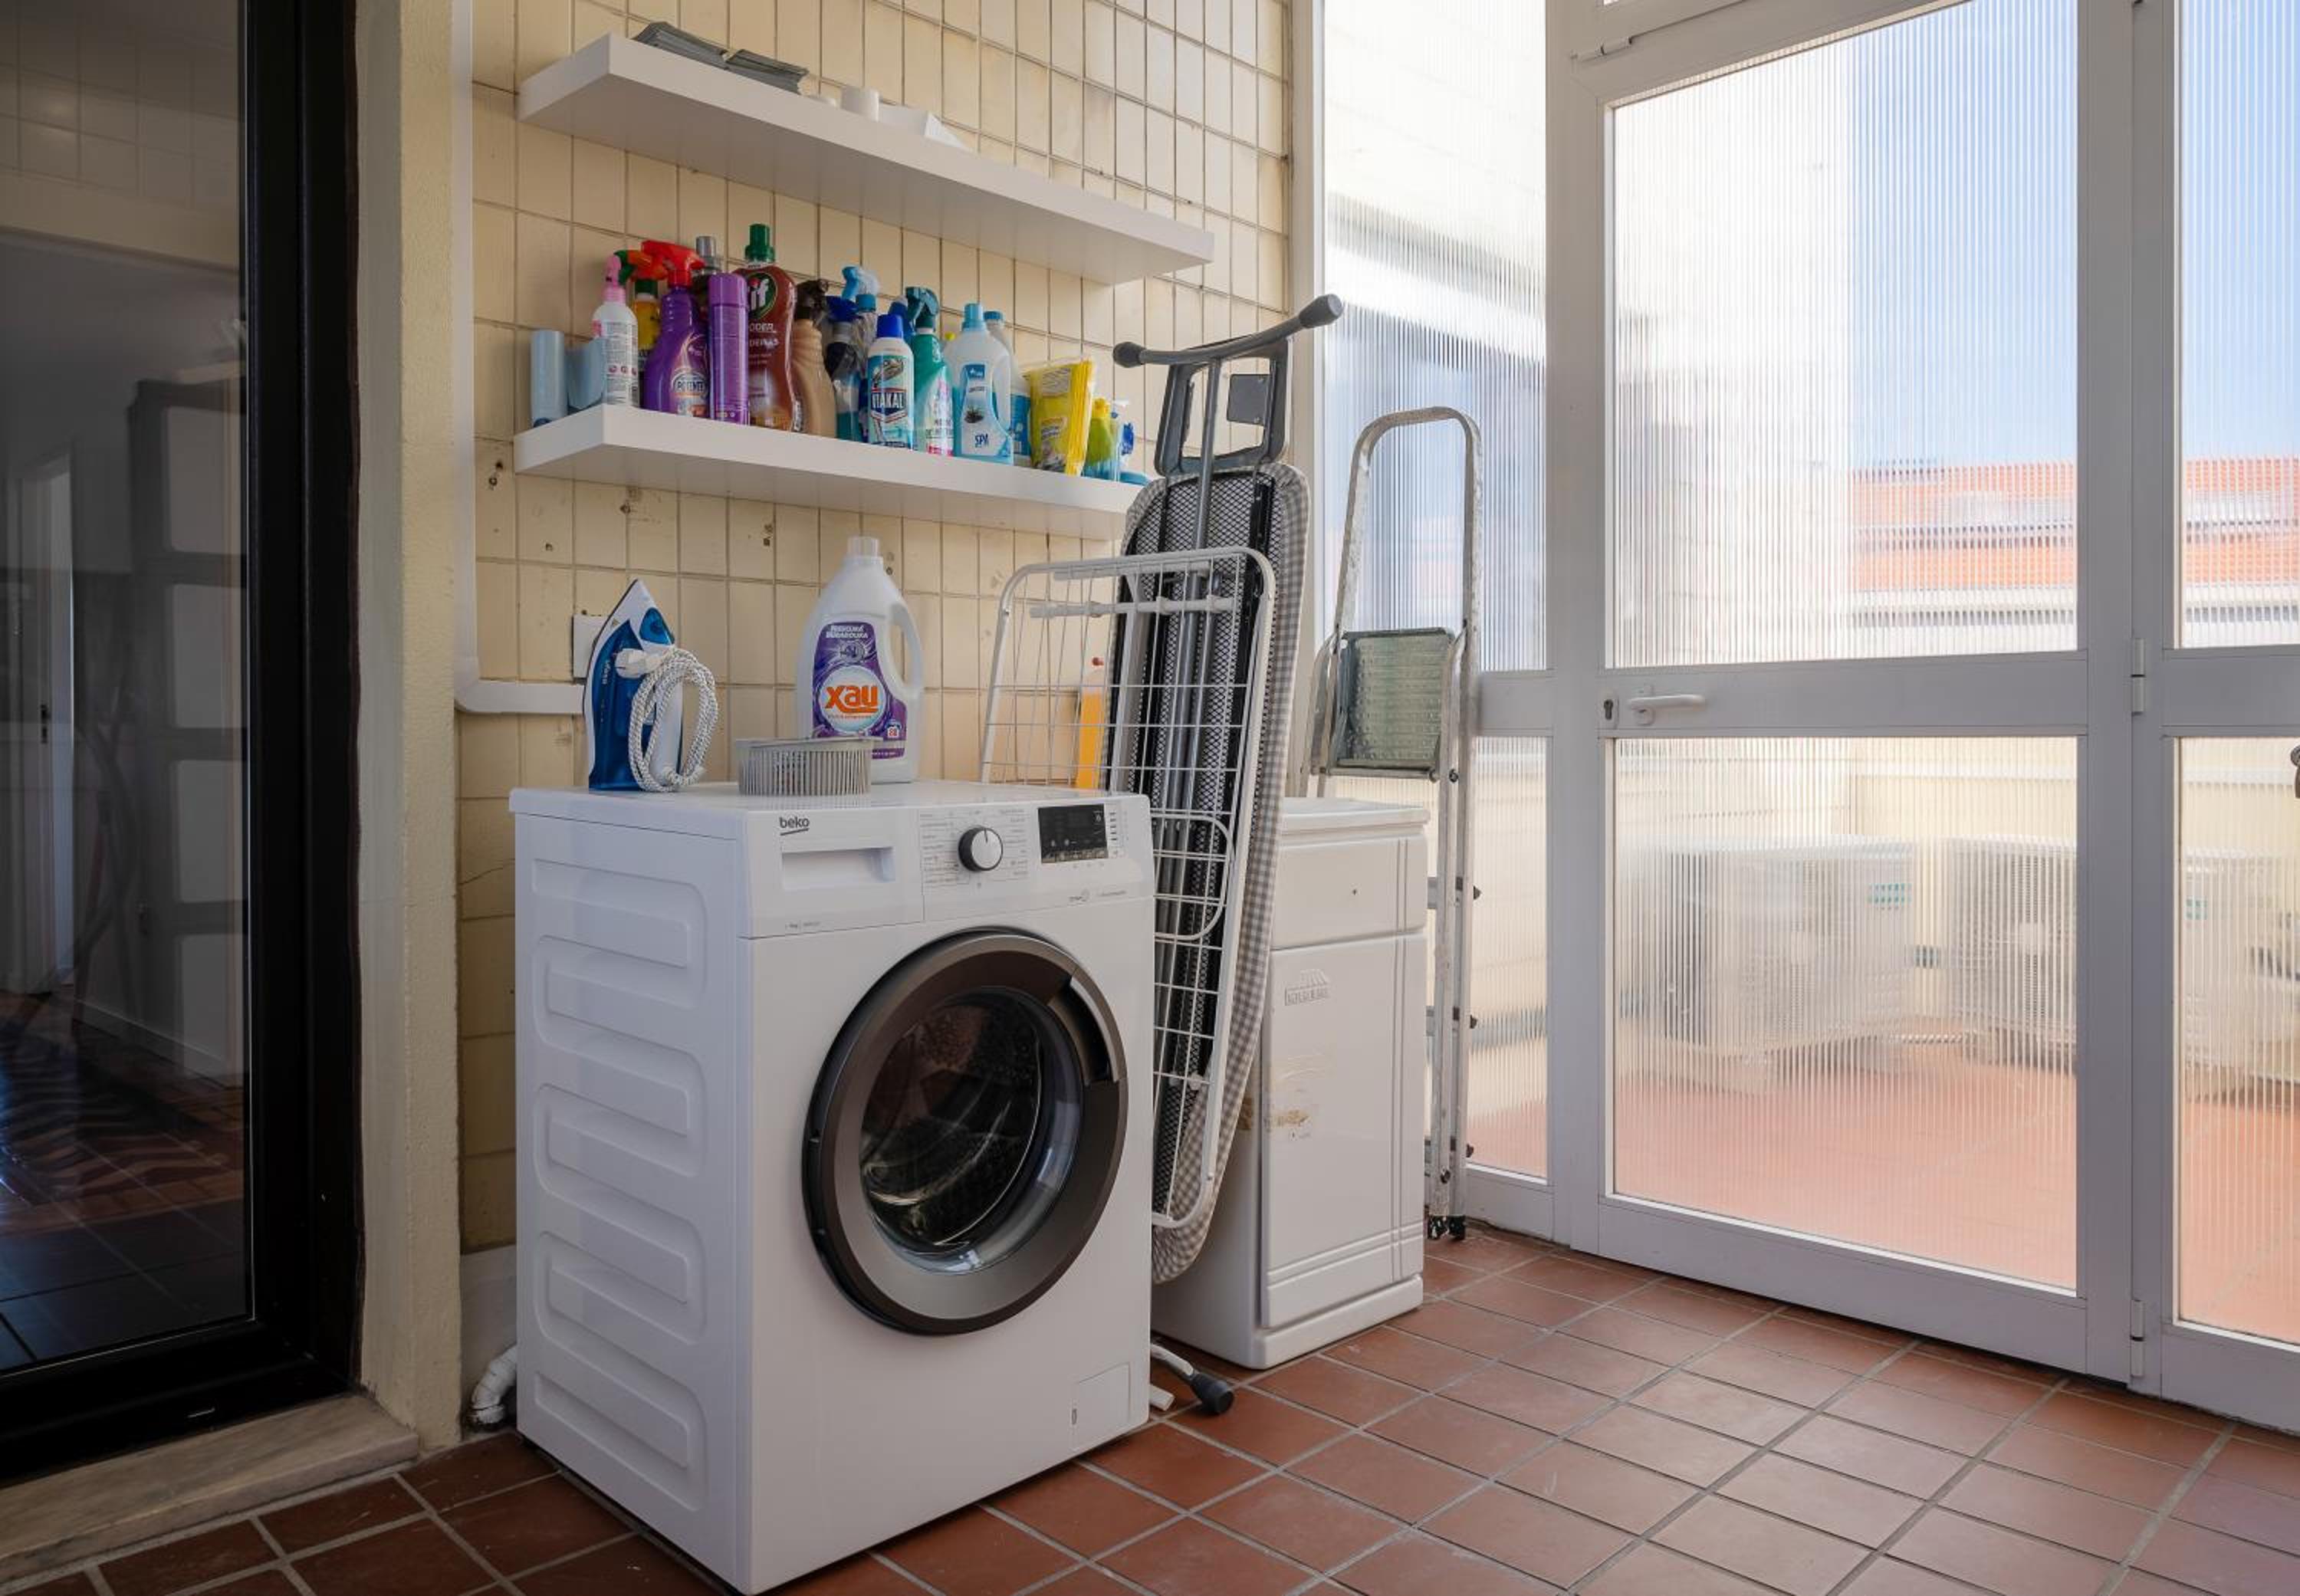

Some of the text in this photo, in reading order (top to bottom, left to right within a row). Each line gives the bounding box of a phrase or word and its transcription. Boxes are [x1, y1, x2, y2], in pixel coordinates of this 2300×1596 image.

[749, 277, 769, 310] if
[872, 392, 903, 409] VIAKAL
[779, 815, 810, 829] beko
